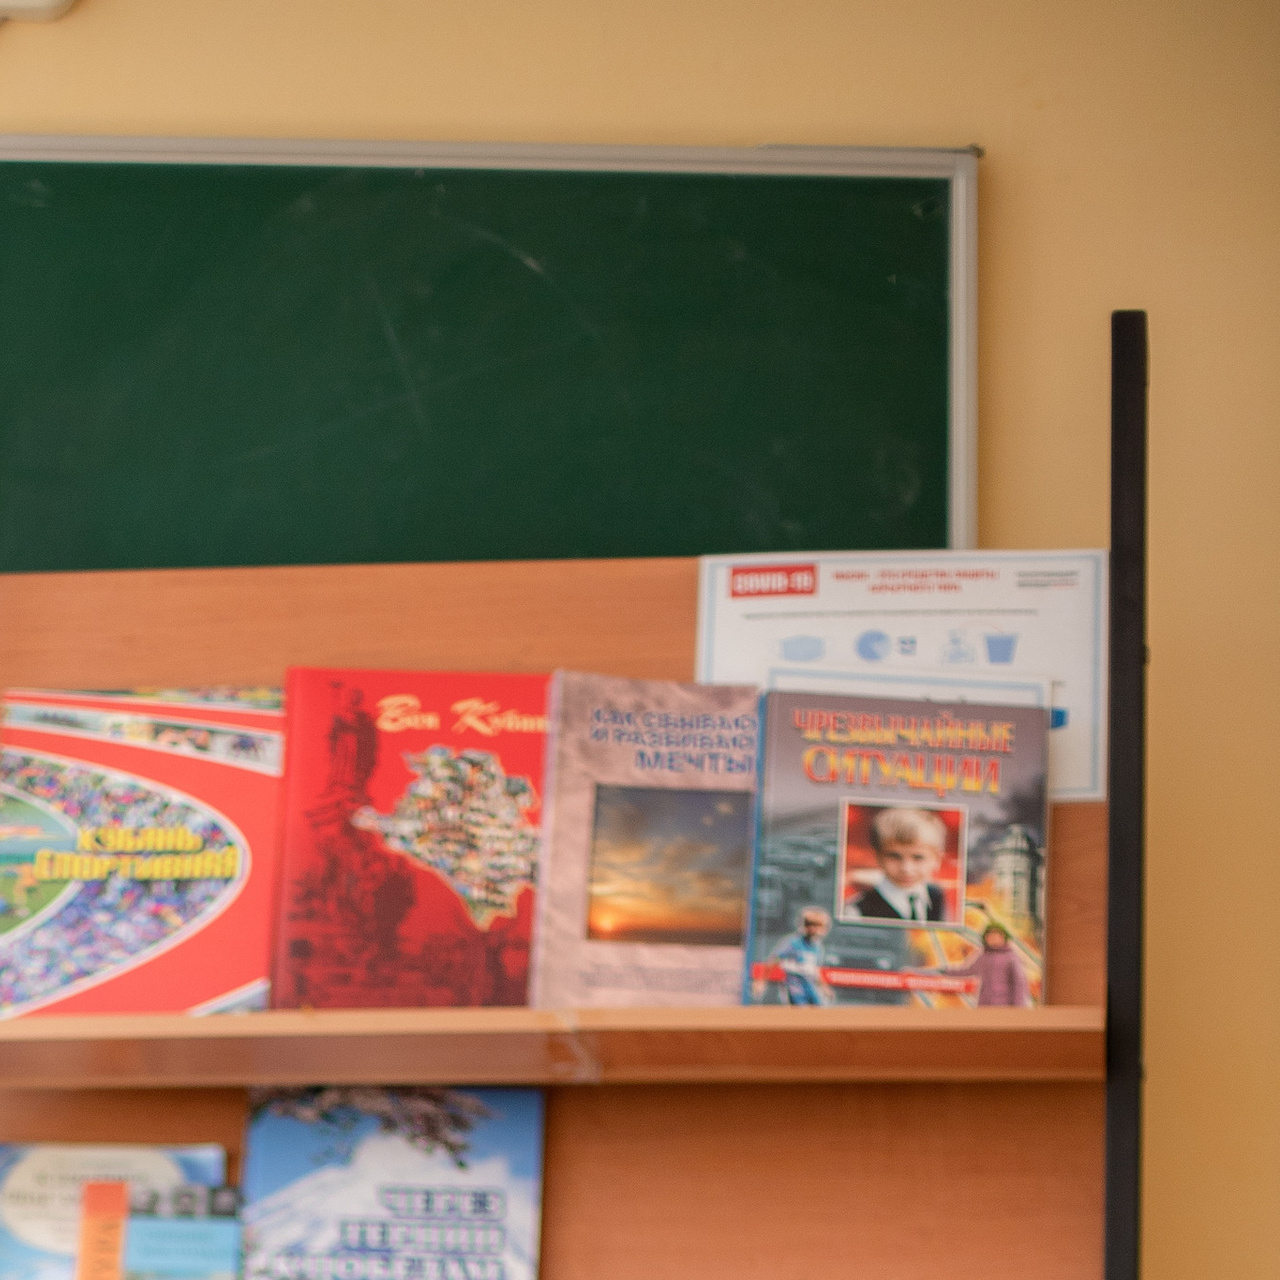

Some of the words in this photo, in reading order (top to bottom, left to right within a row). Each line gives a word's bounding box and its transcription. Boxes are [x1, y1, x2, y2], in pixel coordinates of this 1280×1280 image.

[589, 708, 638, 728] КАК
[791, 708, 1017, 754] ЧРЕЗВЫЧАЙНЫЕ
[588, 725, 610, 743] И
[634, 750, 755, 775] МЕЧТЫ
[802, 744, 1003, 799] СИТУАЦИИ
[76, 825, 203, 852] КУБАНЬ
[32, 847, 237, 880] СПОРТИВНАЯ
